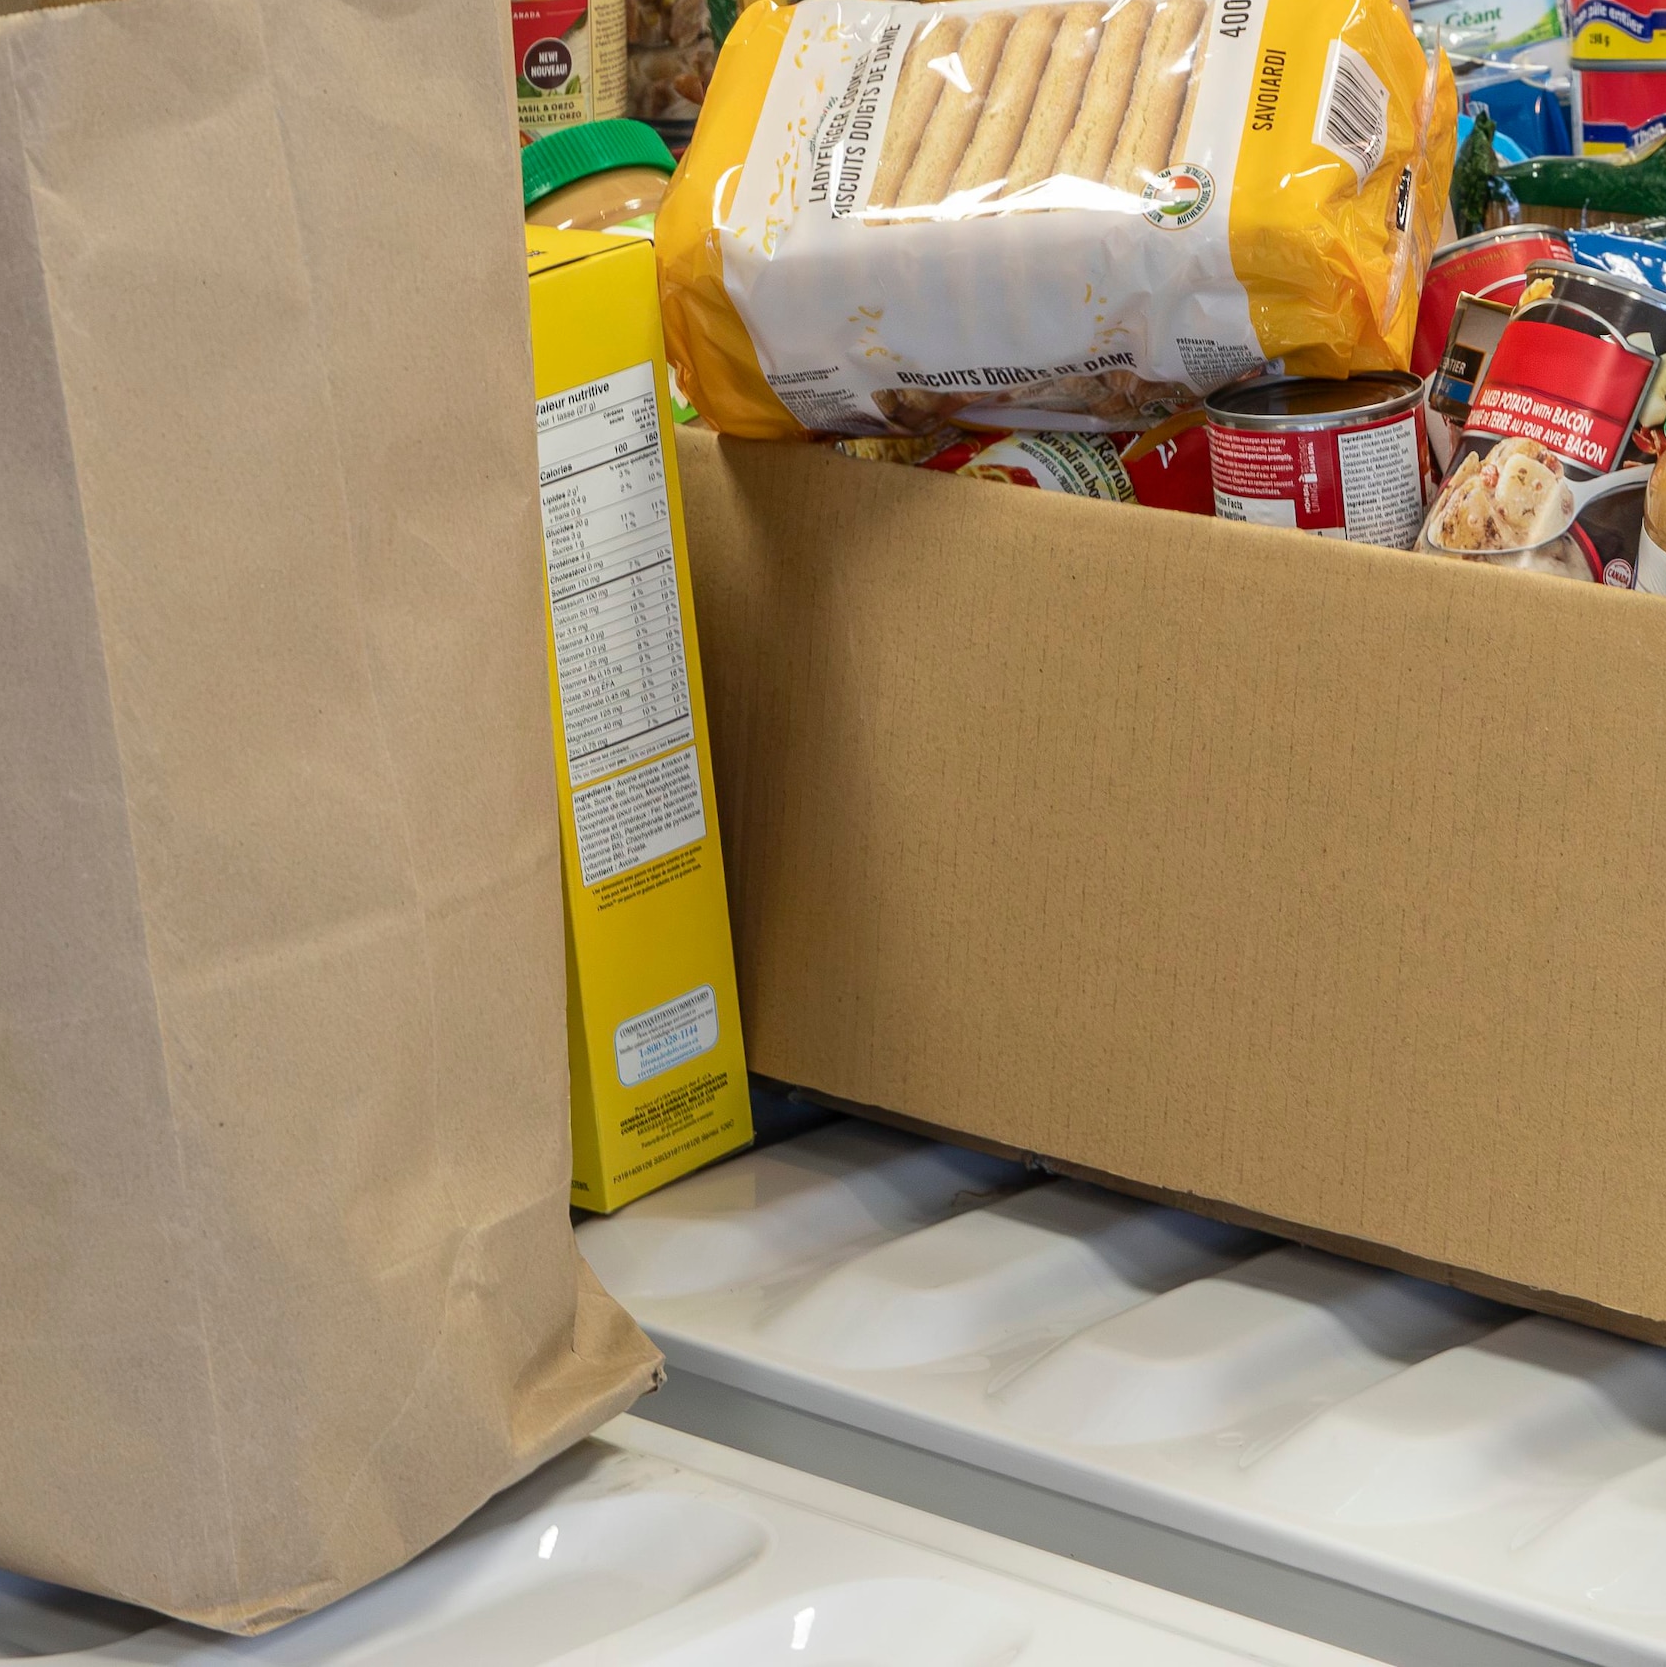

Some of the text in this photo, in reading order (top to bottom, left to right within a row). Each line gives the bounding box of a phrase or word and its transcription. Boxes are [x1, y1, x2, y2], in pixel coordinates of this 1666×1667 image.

[1445, 6, 1502, 26] Géant
[1608, 3, 1645, 35] entier
[874, 23, 901, 63] DAME
[531, 63, 568, 78] NOUVEAU!
[539, 51, 559, 64] NEW!
[867, 65, 887, 85] DE
[1252, 48, 1287, 132] SAVOIARDI
[551, 101, 575, 111] ORZO
[848, 85, 880, 142] DOIGTS
[809, 109, 851, 202] LADYFINGER
[896, 368, 982, 389] BISCUITS
[1053, 363, 1079, 376] DE
[1083, 351, 1137, 371] DAME
[569, 381, 610, 405] nutritive
[1499, 391, 1532, 416] POTATO
[1531, 401, 1553, 420] WITH
[1551, 406, 1594, 437] BACON
[1486, 411, 1608, 466] TERRE AU FOUR AVEC BACON
[540, 441, 629, 482] Calories 100
[1225, 497, 1244, 510] Facts
[1607, 568, 1630, 584] CANADA
[585, 865, 615, 883] Contient
